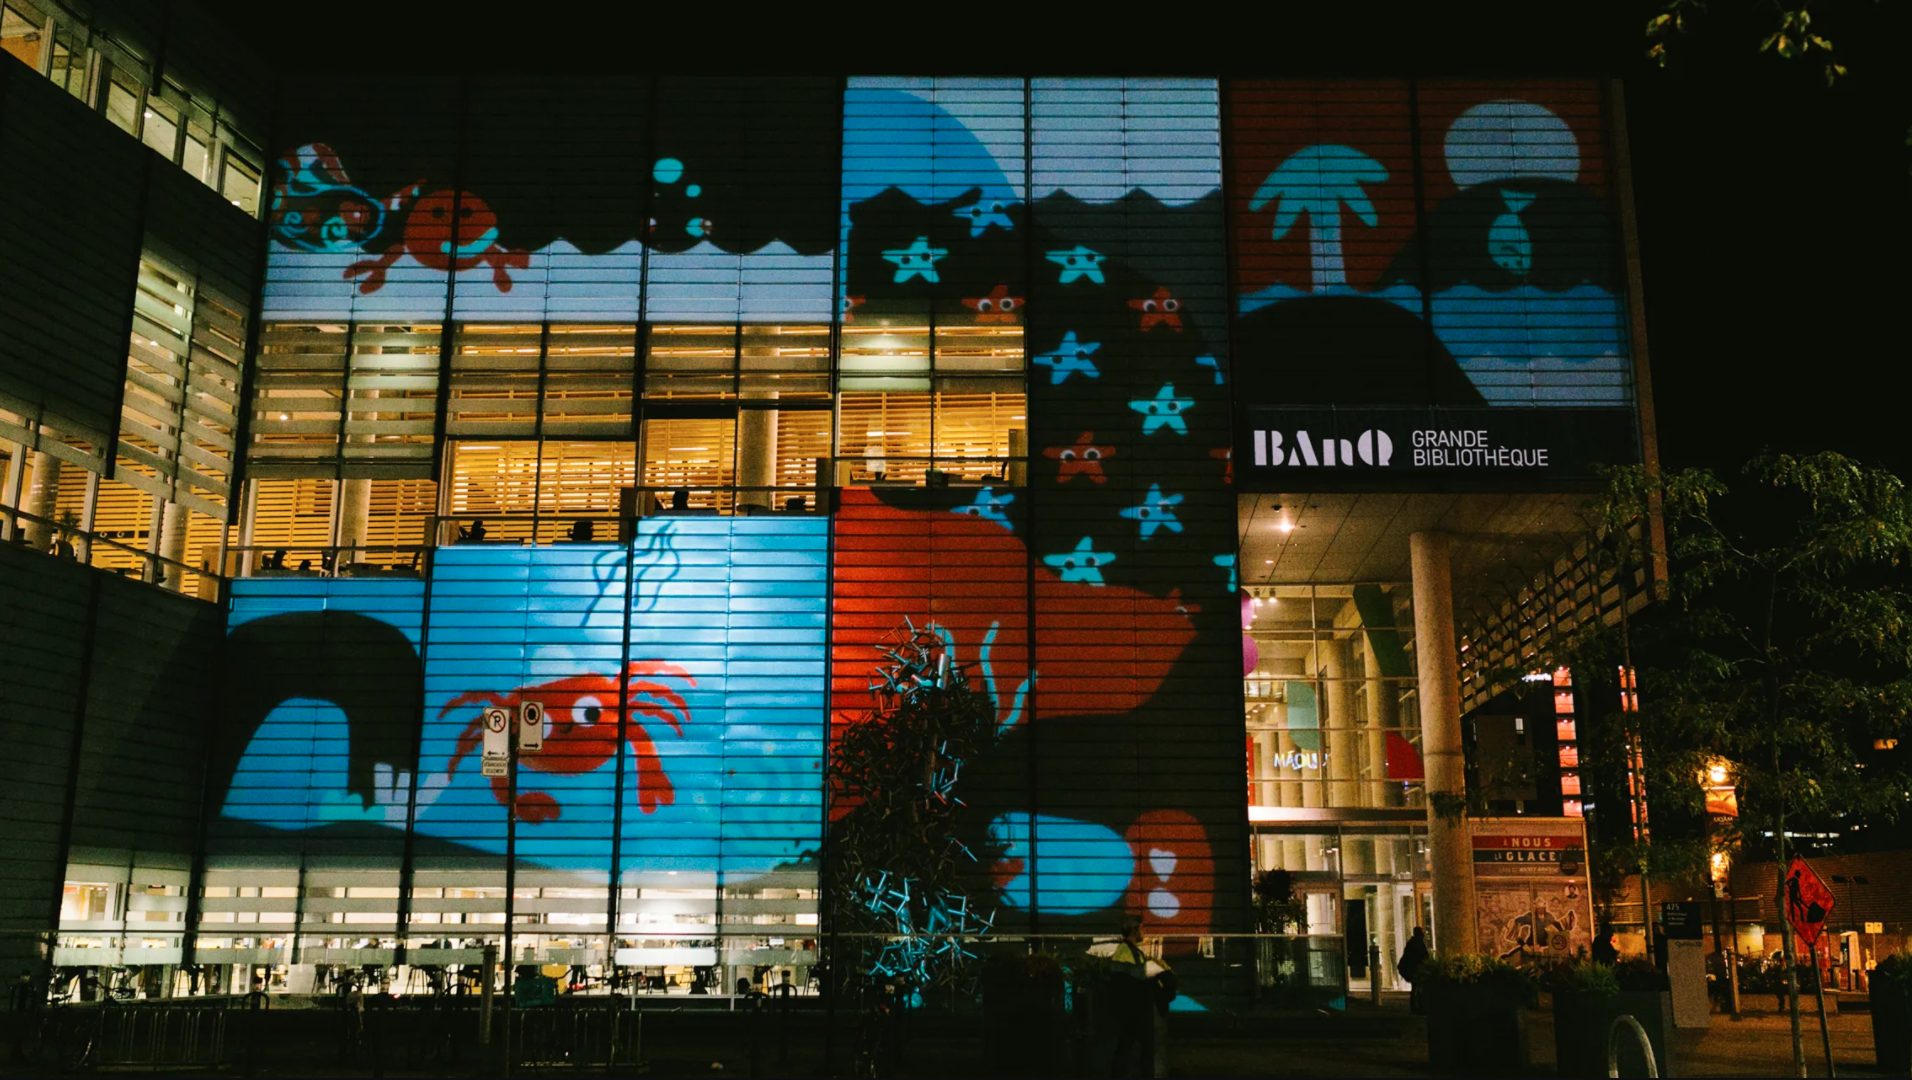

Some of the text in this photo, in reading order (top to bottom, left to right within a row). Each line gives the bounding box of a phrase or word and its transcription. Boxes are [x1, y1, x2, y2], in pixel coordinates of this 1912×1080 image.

[1253, 429, 1394, 467] BAnQ
[1412, 430, 1488, 448] GRANDE
[1413, 445, 1549, 467] BIBLIOTHÈQUE
[1512, 837, 1552, 848] NOUS
[1506, 851, 1557, 862] GLACE
